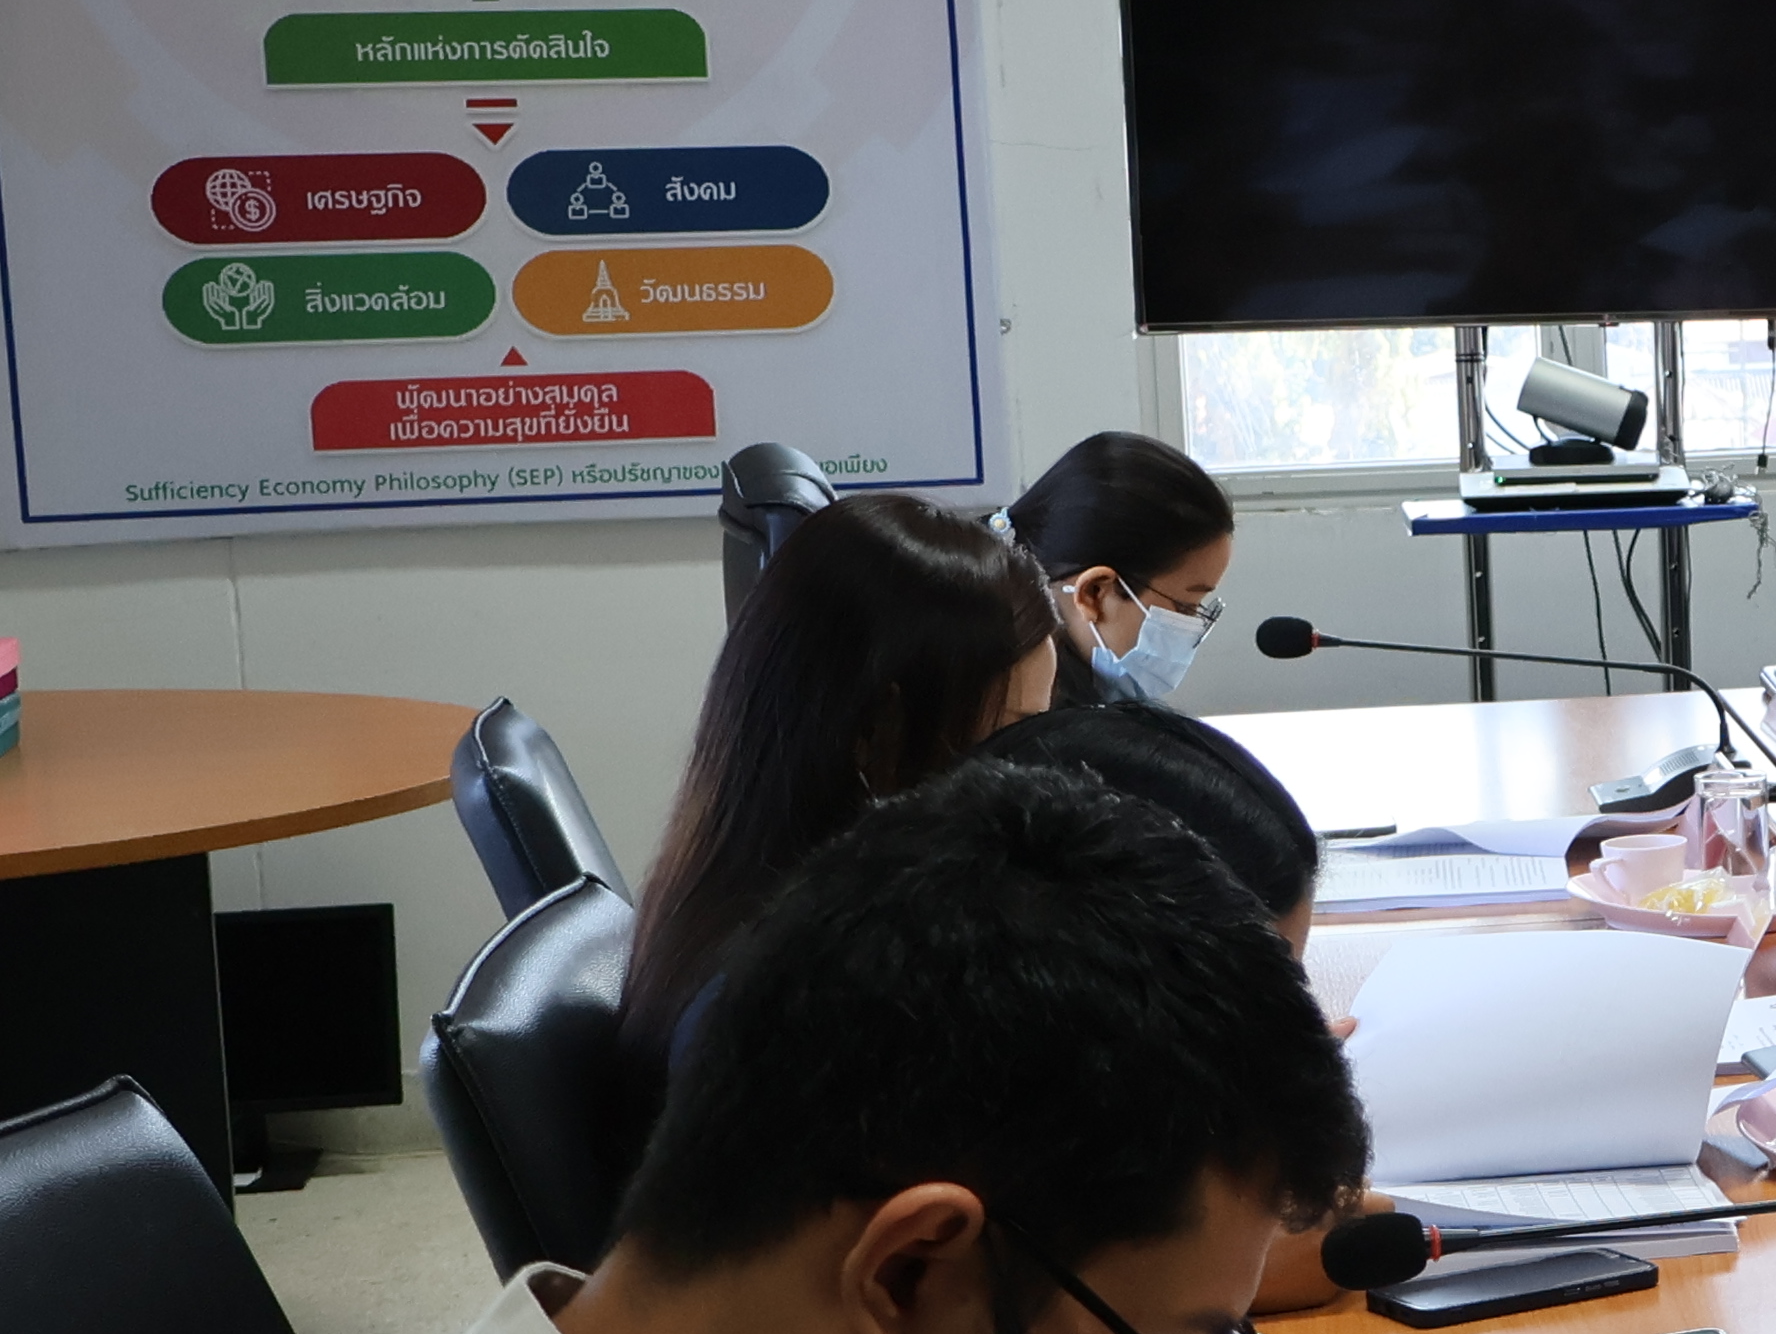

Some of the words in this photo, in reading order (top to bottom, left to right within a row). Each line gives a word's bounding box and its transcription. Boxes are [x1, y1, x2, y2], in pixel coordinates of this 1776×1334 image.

[355, 29, 610, 64] หลักแห่งการตัดสินใจ
[306, 181, 423, 216] เศรษฐกิจ
[664, 175, 738, 203] สังคม
[304, 281, 446, 317] สิ่งแวดล้อม
[639, 274, 766, 305] วัฒนธรรม
[395, 381, 619, 410] พัฒนาอย่างสมดุล
[389, 405, 630, 442] เพื่อความสุขที่ยั่งยืน
[125, 480, 249, 503] Sufficiency
[259, 477, 366, 499] Economy
[375, 470, 500, 494] Philosophy
[508, 464, 564, 488] (SEP)
